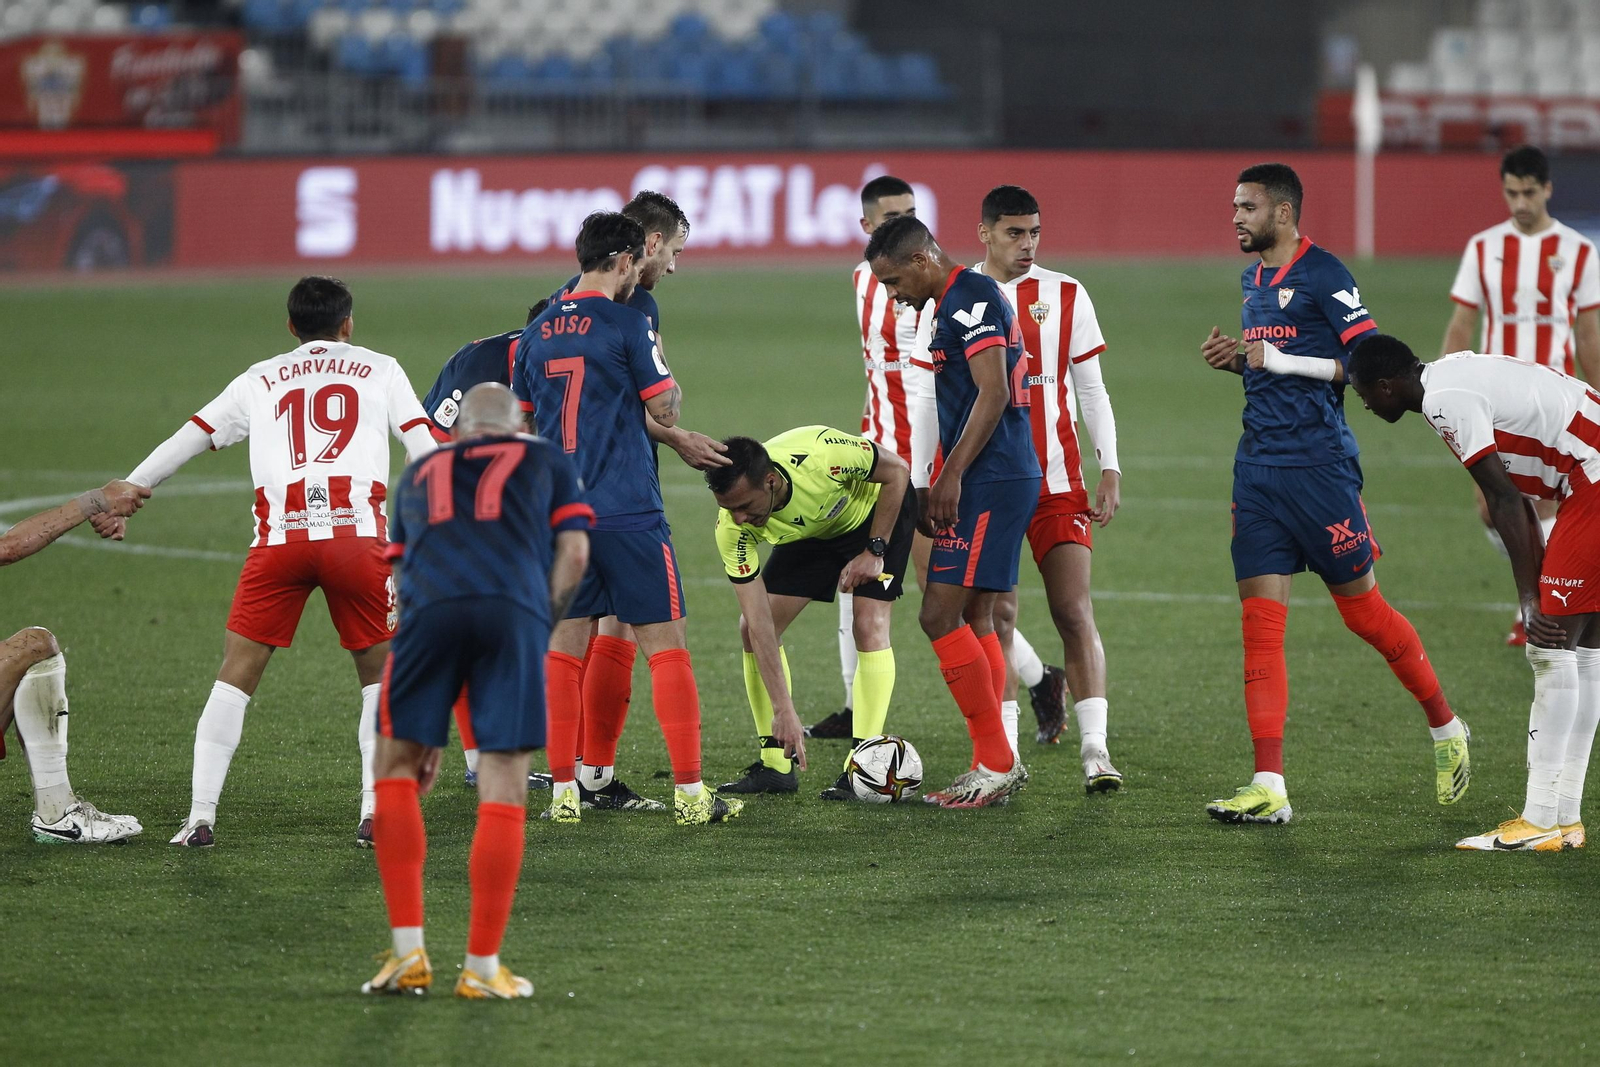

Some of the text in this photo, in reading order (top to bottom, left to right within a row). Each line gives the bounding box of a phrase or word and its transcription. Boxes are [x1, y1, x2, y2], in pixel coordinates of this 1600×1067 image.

[787, 163, 937, 246] Len
[541, 314, 592, 340] SUSO
[961, 324, 997, 342] Valvoline
[1243, 325, 1297, 341] RATHON
[260, 359, 372, 392] J. CARVALHO
[544, 356, 585, 454] 7
[275, 383, 359, 470] 19
[413, 441, 527, 525] 17
[737, 532, 749, 565] WÜRTH
[934, 537, 970, 551] everfx
[1332, 531, 1368, 554] everfx
[1244, 668, 1267, 678] SFC
